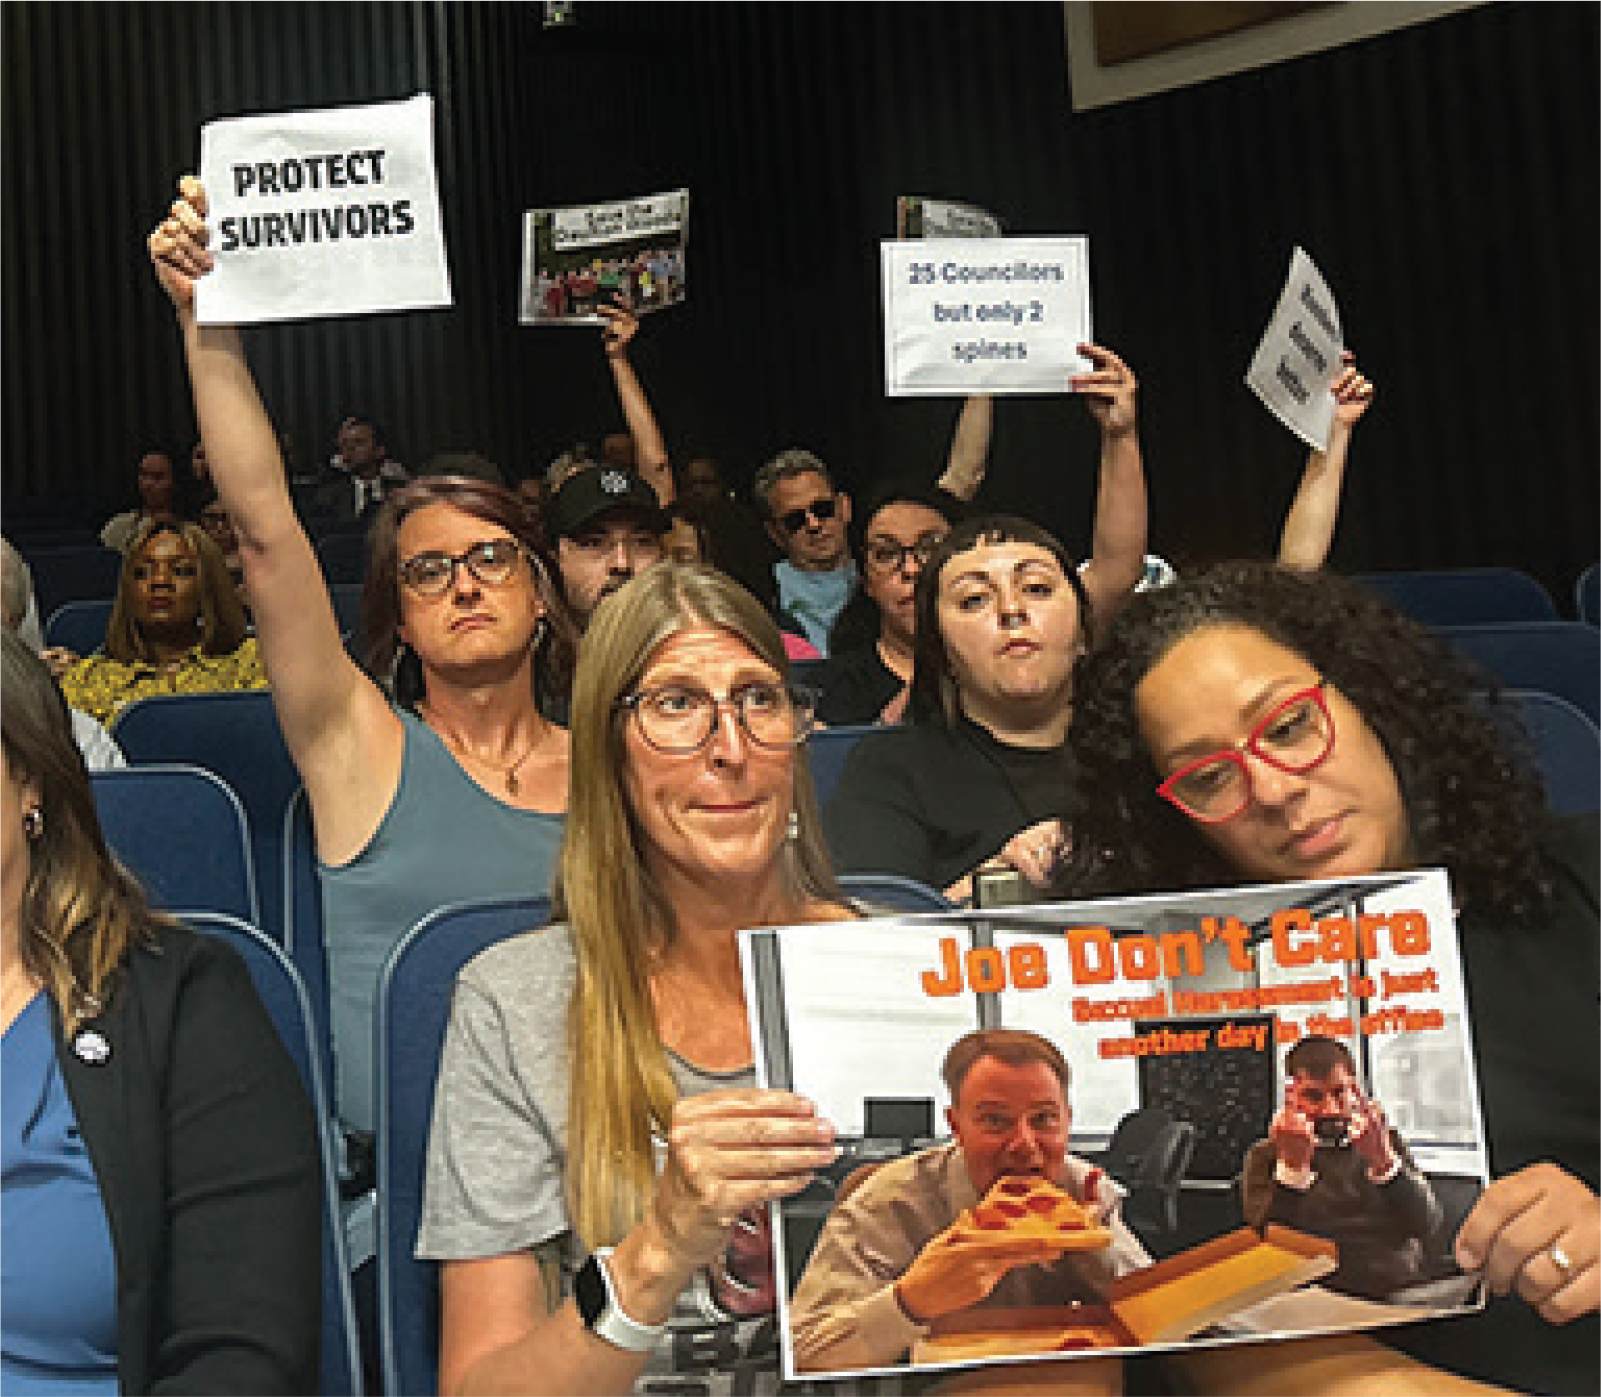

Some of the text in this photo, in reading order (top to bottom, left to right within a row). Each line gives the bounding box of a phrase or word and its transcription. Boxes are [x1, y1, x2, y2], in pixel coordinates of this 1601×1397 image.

[233, 150, 385, 196] PROTECT
[220, 200, 415, 251] SURVIVORS
[909, 263, 935, 285] 25
[933, 301, 1044, 326] but only 2
[953, 338, 1027, 362] spines
[922, 908, 1432, 998] Joe Don't Care
[1380, 967, 1439, 1000] just
[1099, 1029, 1209, 1059] another
[1217, 1024, 1267, 1051] day
